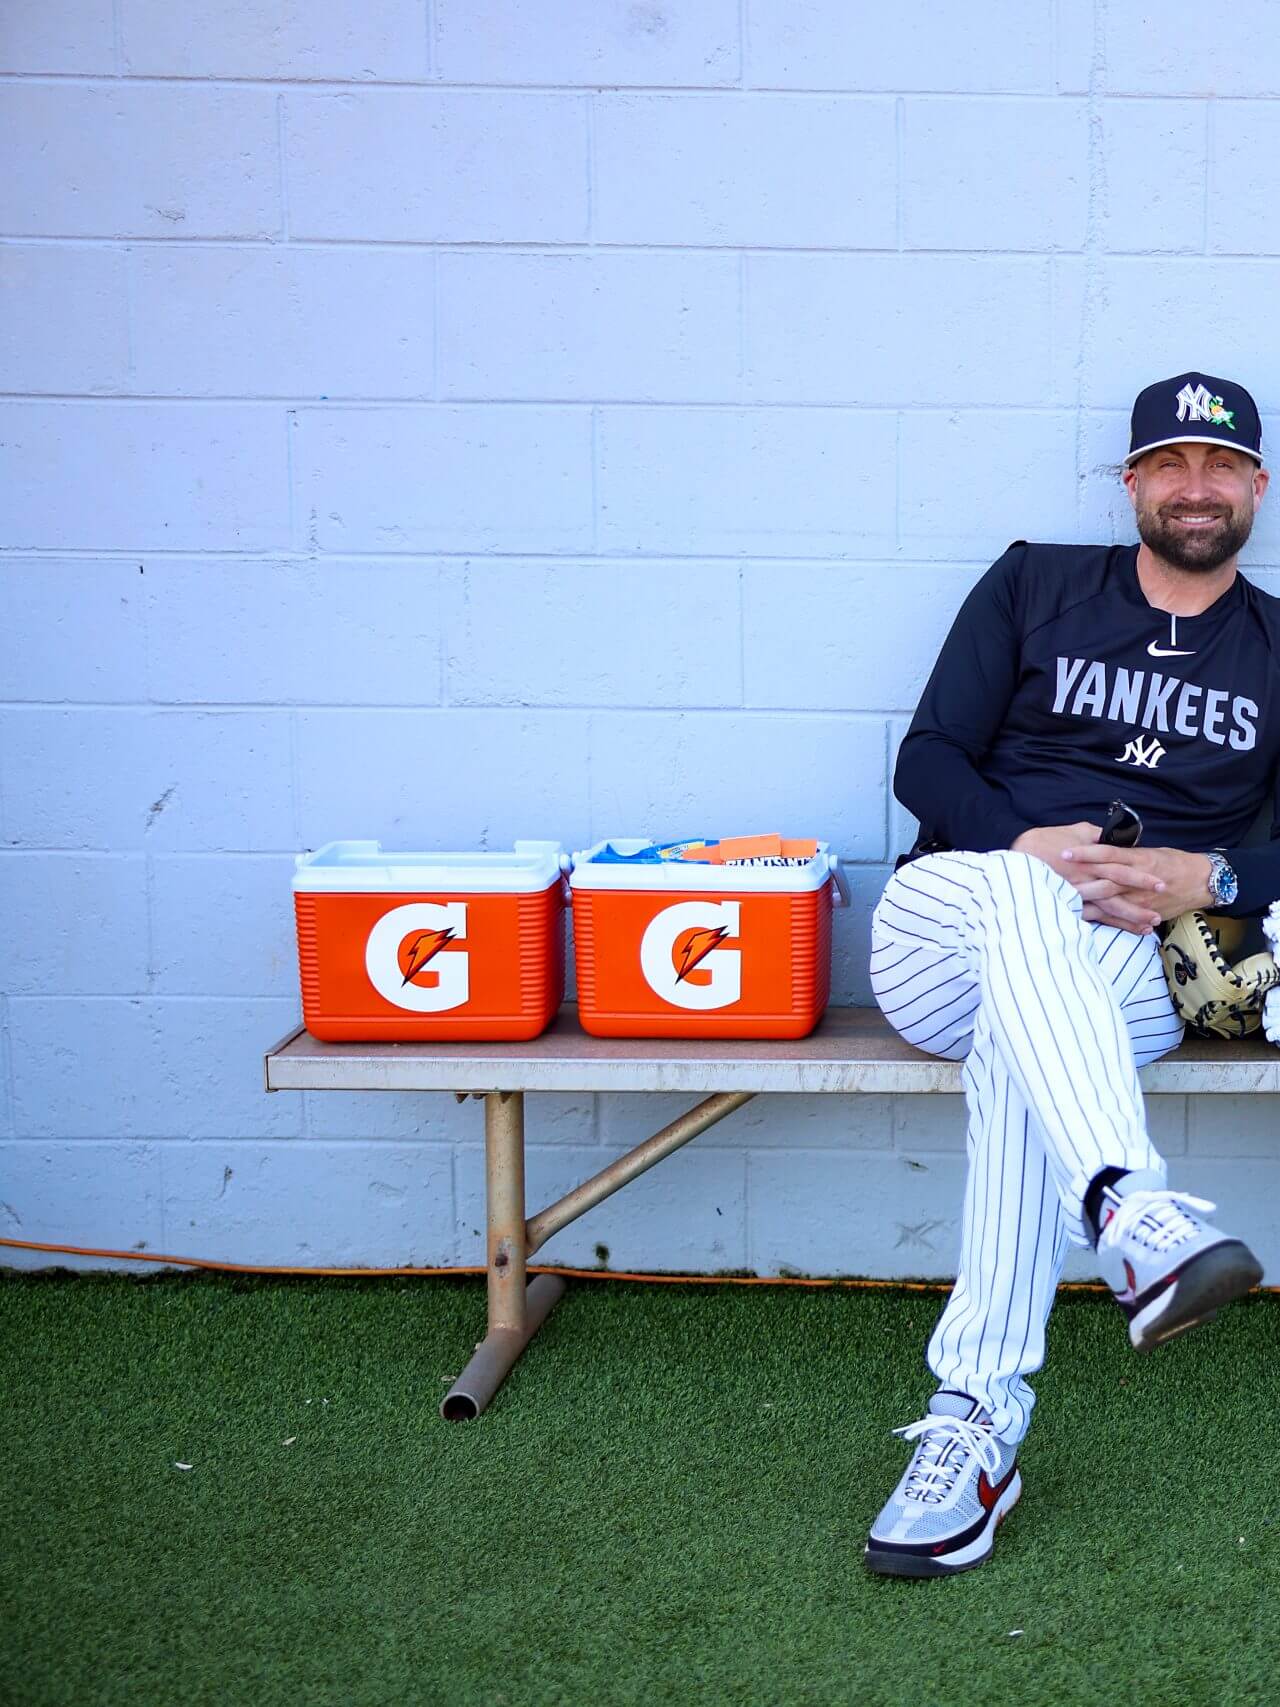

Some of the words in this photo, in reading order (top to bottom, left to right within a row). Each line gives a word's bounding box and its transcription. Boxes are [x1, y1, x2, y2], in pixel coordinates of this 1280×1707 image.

[1052, 657, 1258, 750] YANKEES
[1115, 734, 1167, 768] NY
[365, 902, 470, 1012] G
[640, 901, 742, 1010] G
